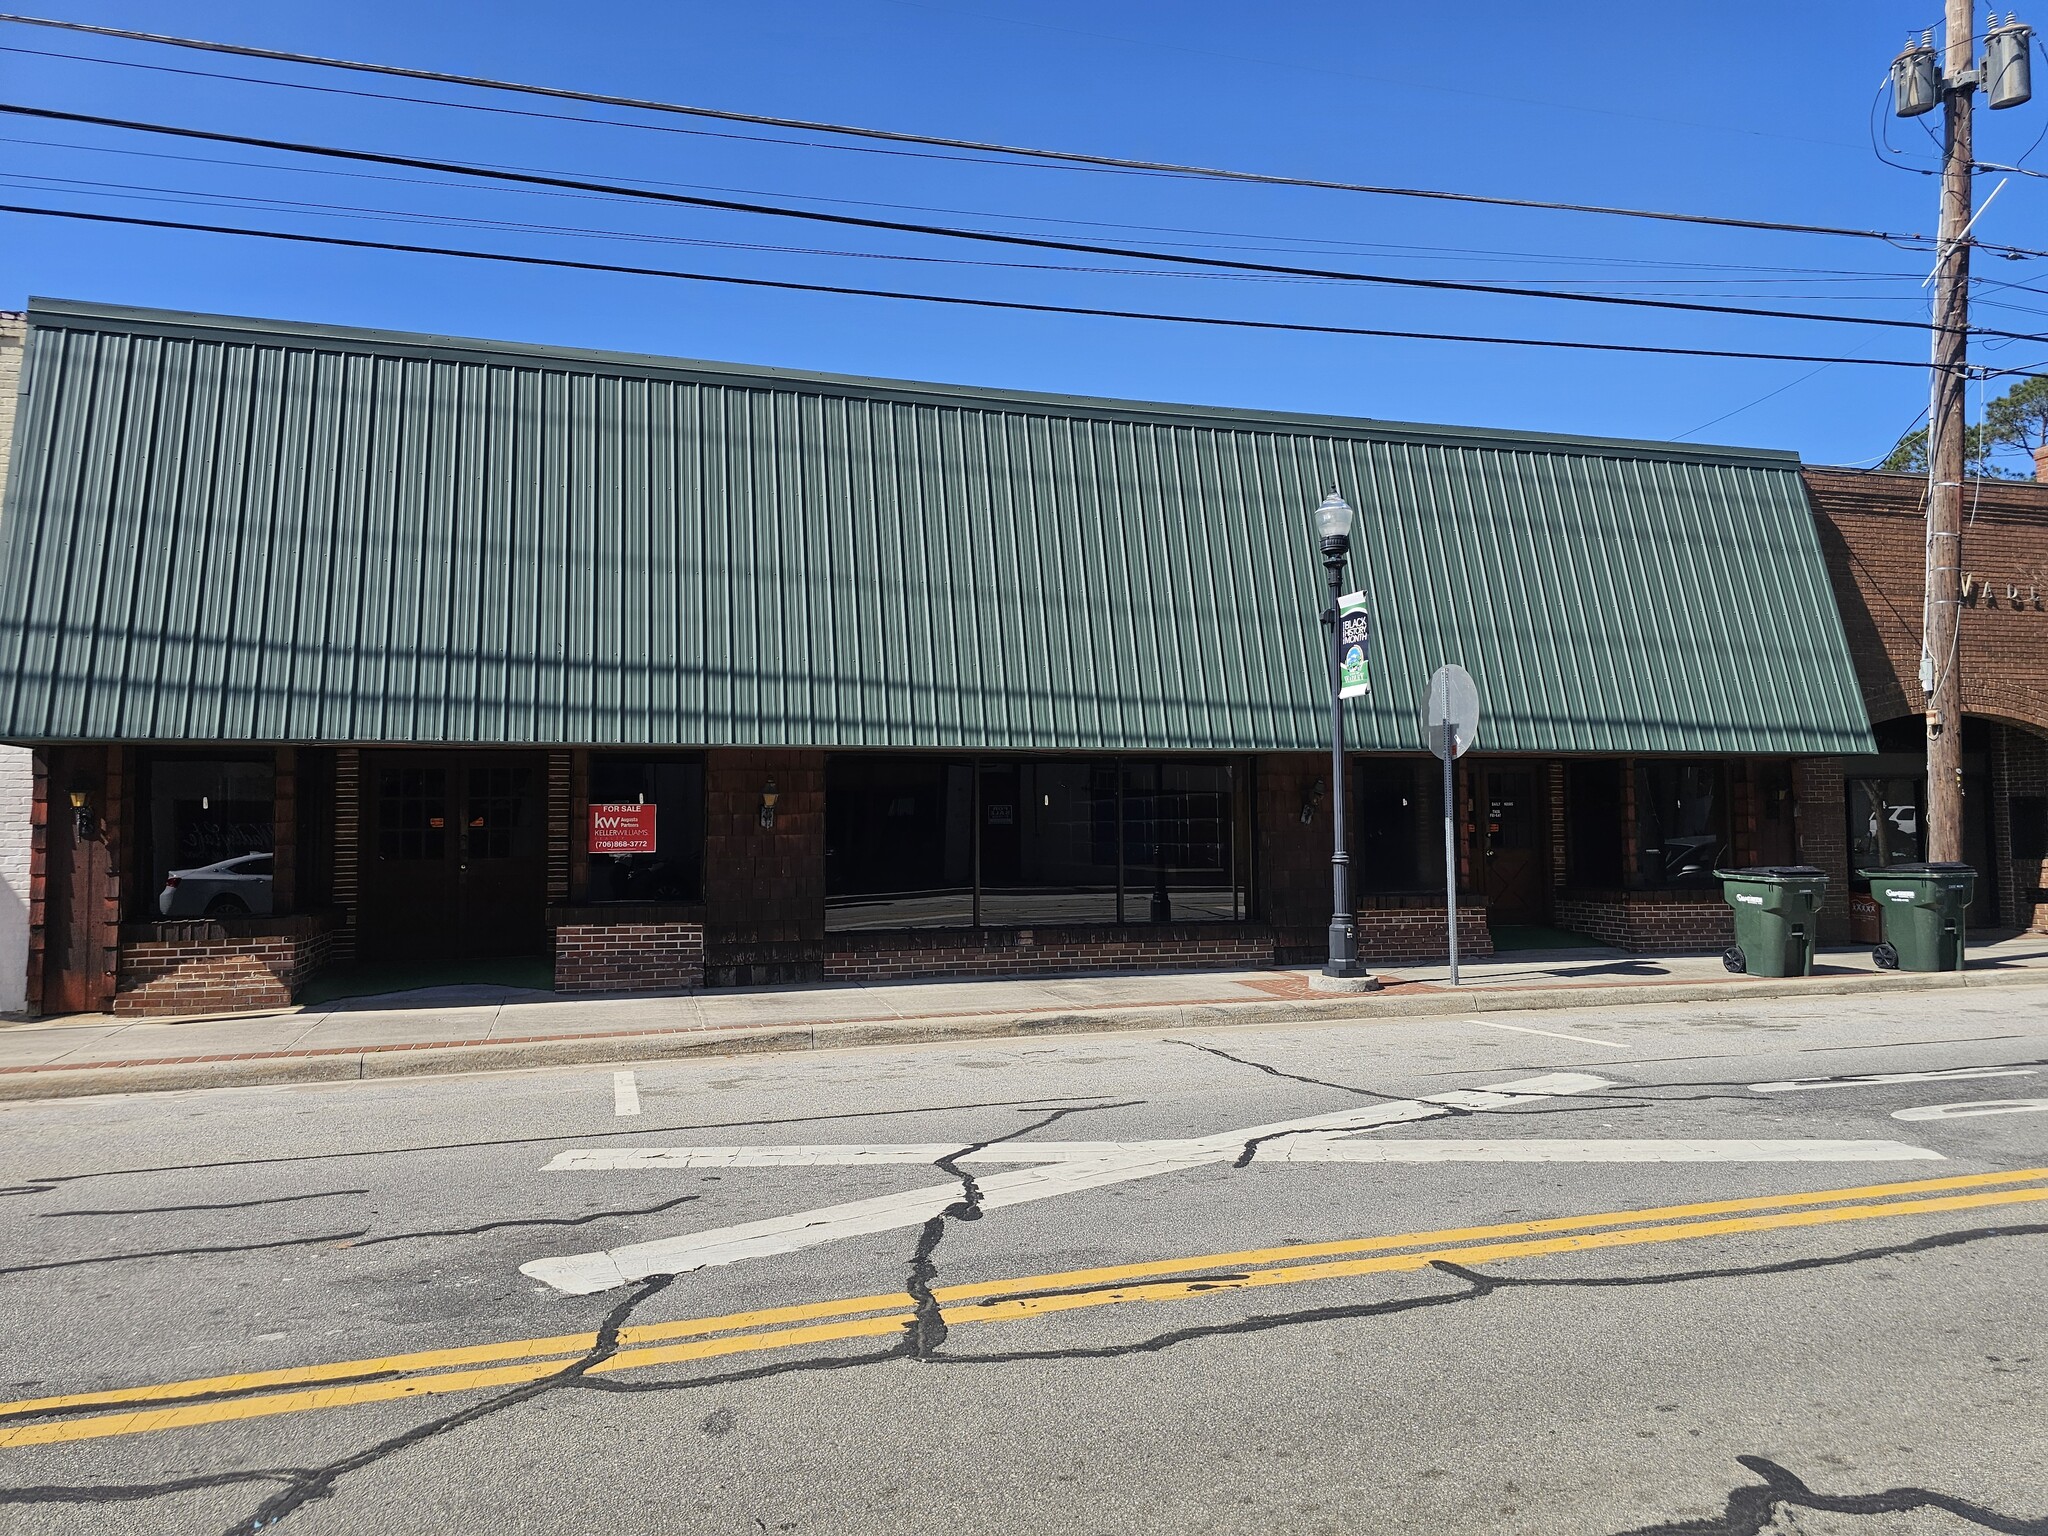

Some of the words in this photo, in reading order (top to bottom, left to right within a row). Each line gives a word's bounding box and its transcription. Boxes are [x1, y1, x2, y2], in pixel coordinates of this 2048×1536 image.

[1344, 616, 1367, 630] BLACK
[1344, 625, 1367, 637] HISTORY
[1344, 632, 1368, 645] MONTH
[595, 840, 648, 849] (706)868-3772
